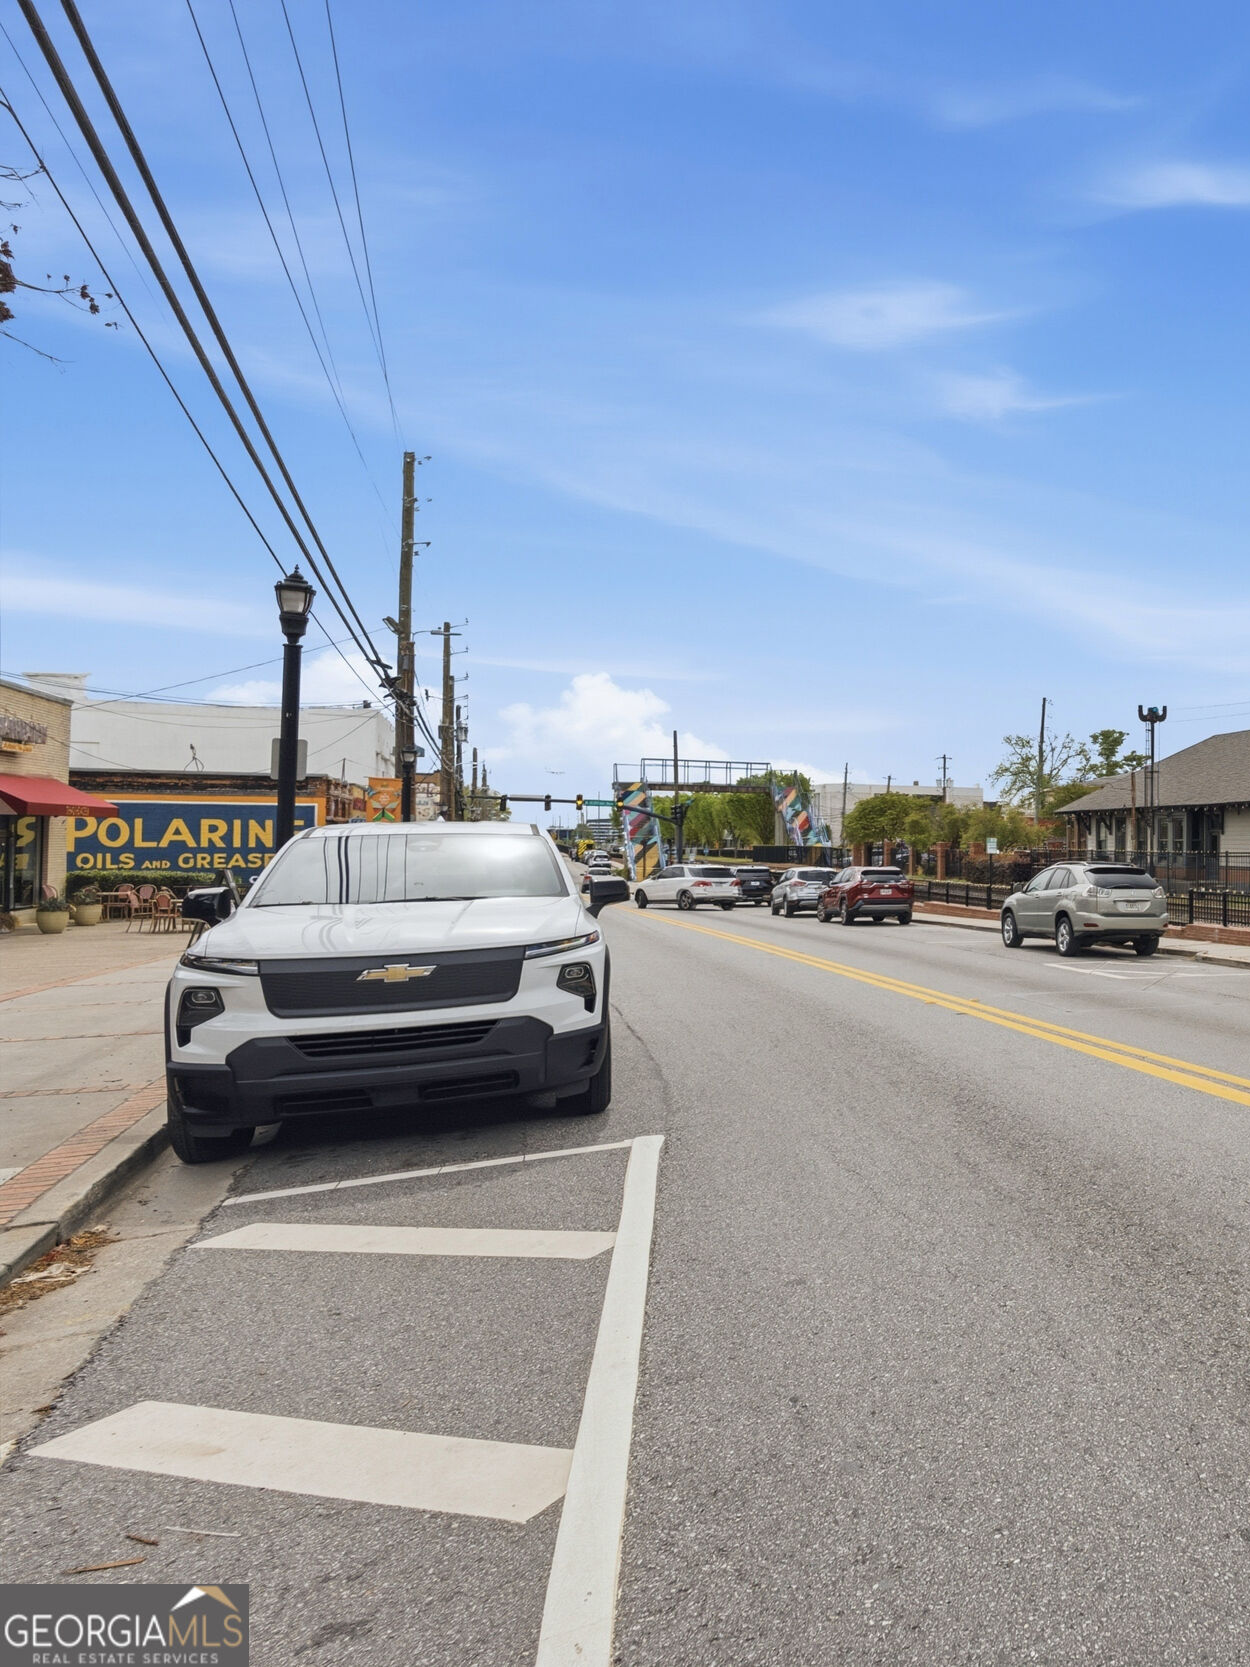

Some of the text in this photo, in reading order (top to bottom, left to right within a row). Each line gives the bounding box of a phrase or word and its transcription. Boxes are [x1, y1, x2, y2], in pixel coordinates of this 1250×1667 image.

[67, 817, 305, 852] POLARIN
[75, 852, 136, 869] OILS
[141, 860, 171, 869] AND
